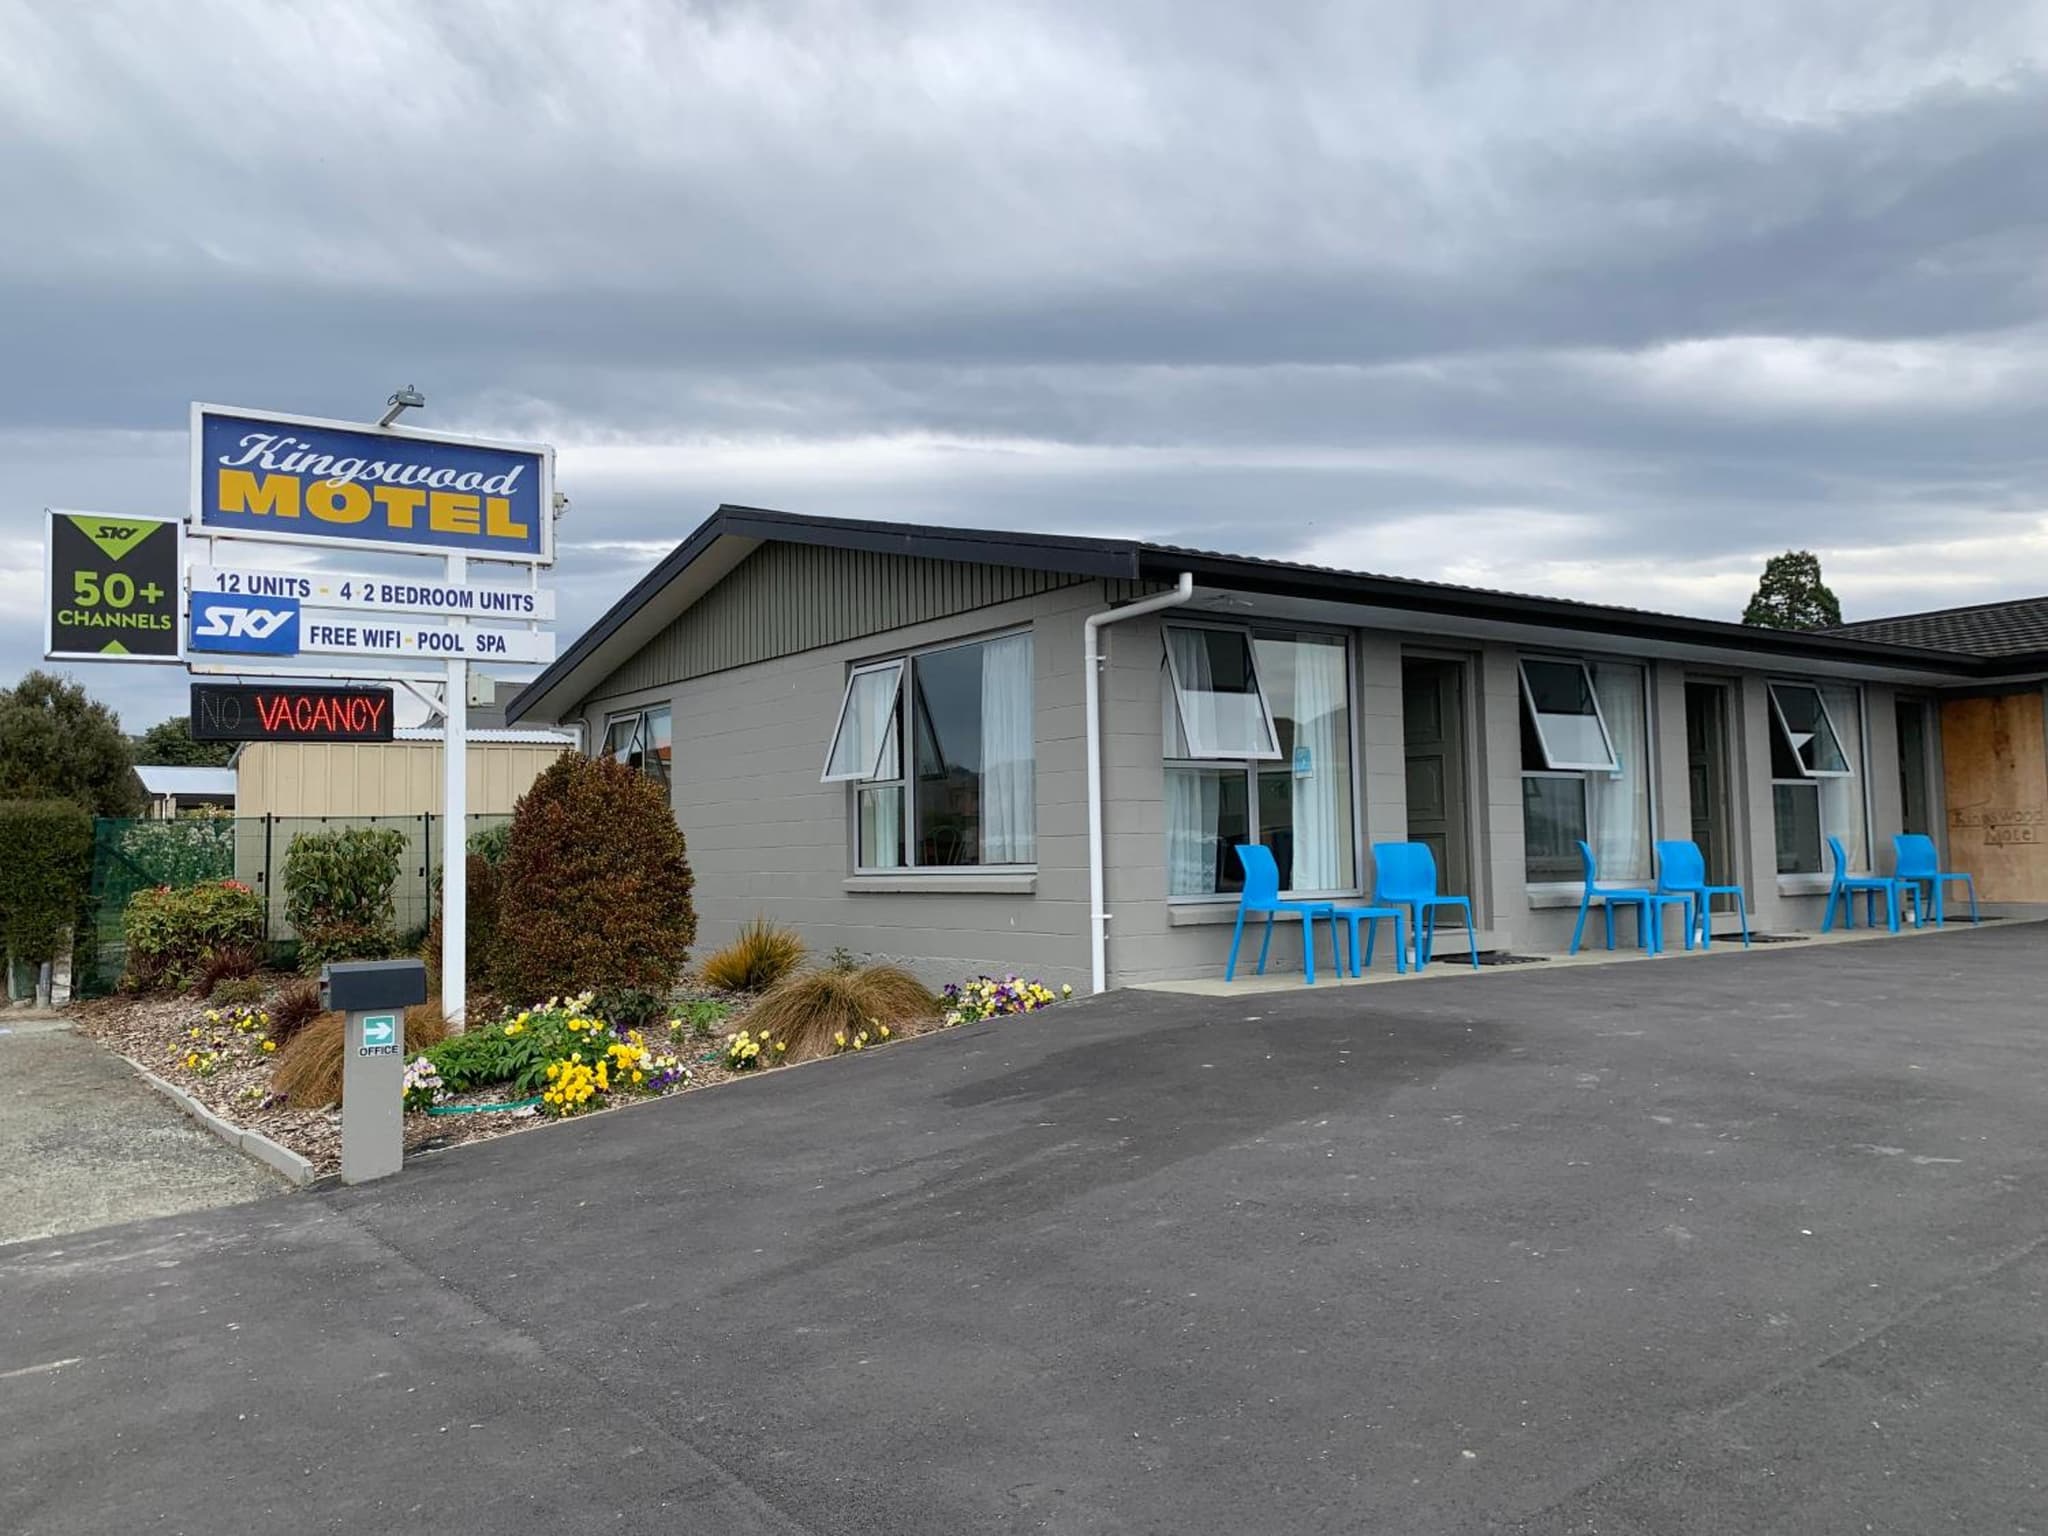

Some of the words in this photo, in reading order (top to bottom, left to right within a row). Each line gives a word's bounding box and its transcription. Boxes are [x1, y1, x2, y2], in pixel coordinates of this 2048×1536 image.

[219, 433, 525, 495] Kingswood
[219, 468, 528, 539] MOTEL
[95, 526, 139, 540] SKY
[74, 571, 164, 608] 50+
[216, 573, 241, 593] 12
[247, 575, 311, 598] UNITS
[340, 582, 352, 601] 4
[364, 584, 375, 602] 2
[381, 585, 473, 609] BEDROOM
[480, 592, 534, 612] UNITS
[57, 610, 172, 630] CHANNELS
[195, 606, 295, 639] SKY
[310, 625, 357, 647] FREE
[362, 629, 401, 649] WIFI
[418, 632, 464, 652] POOL
[476, 634, 506, 653] SPA
[201, 693, 241, 730] NO
[256, 696, 385, 732] VACANCY
[359, 1045, 399, 1057] OFFICE
